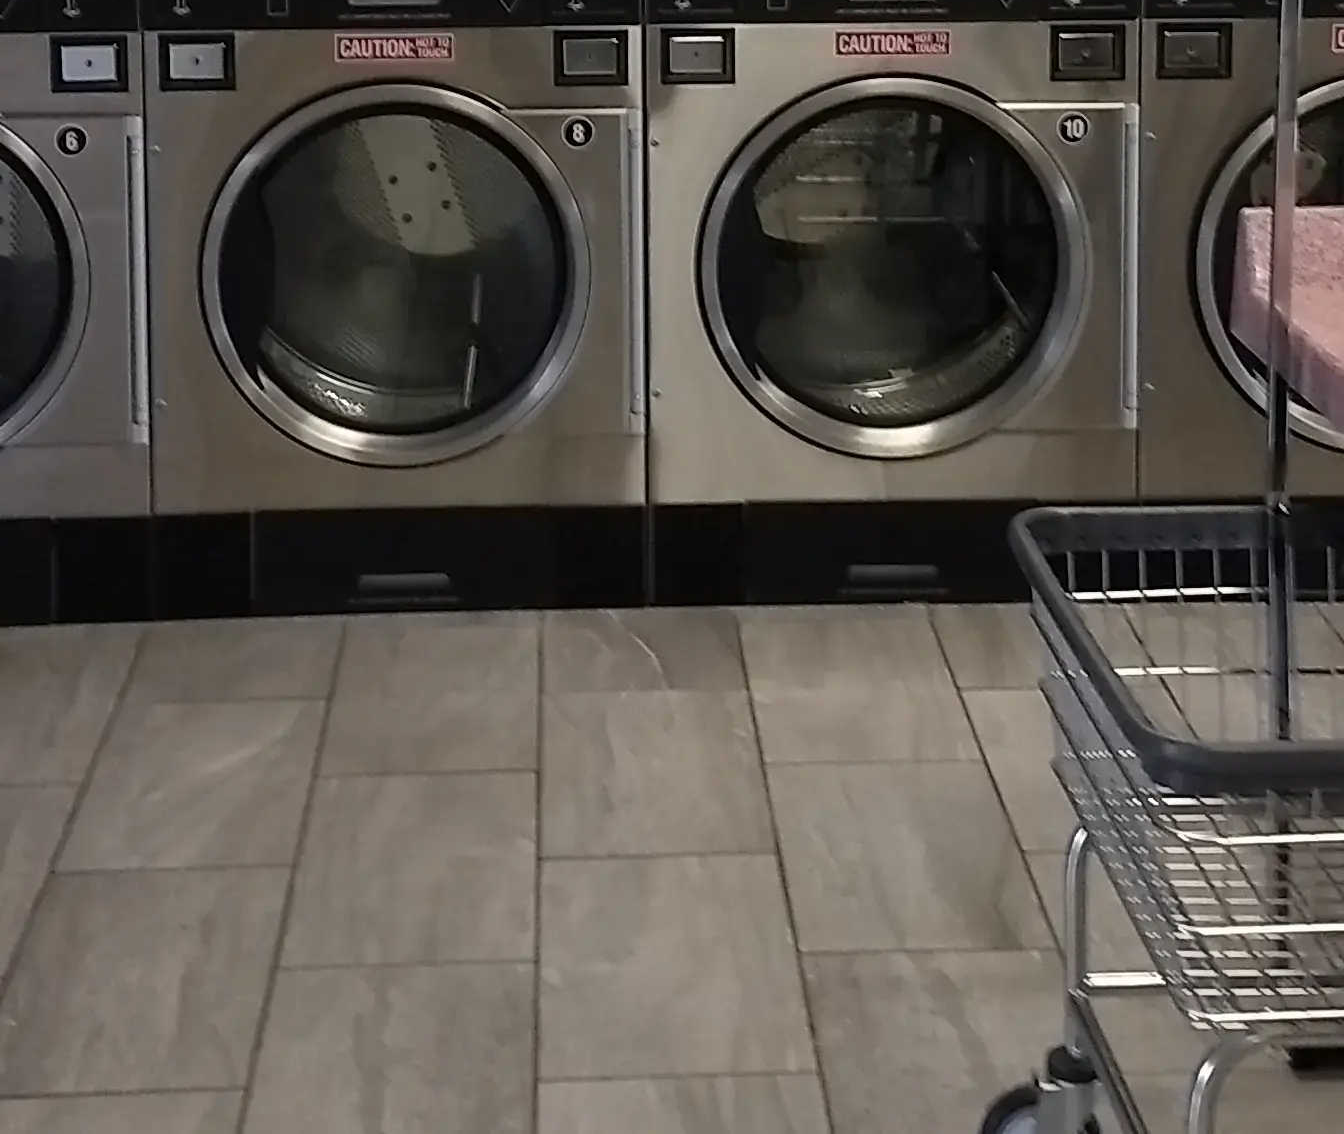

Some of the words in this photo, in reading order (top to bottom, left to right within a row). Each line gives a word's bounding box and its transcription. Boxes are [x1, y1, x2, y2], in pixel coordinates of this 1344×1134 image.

[340, 38, 415, 57] CAUTION:
[839, 35, 913, 53] CAUTION:
[572, 123, 585, 142] 8
[1064, 118, 1084, 138] 10
[65, 131, 79, 151] 6
